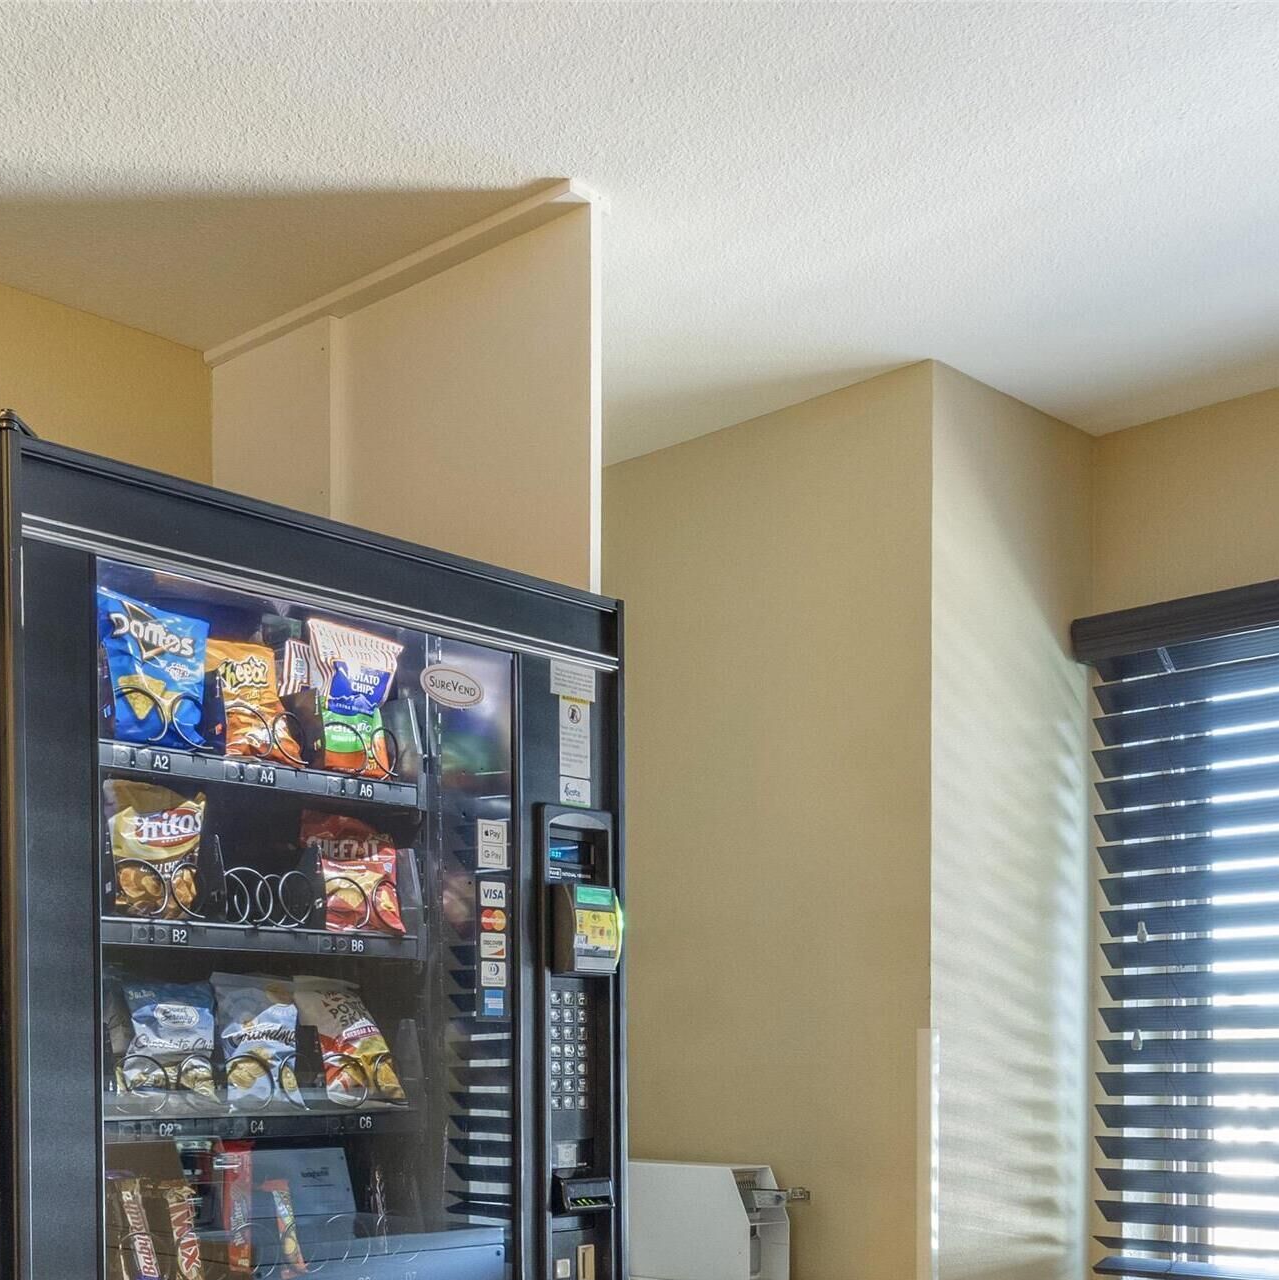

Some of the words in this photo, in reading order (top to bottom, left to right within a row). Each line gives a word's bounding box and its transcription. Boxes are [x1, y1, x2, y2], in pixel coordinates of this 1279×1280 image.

[109, 612, 194, 657] Doritos
[351, 681, 375, 696] CHIPS
[153, 756, 169, 769] A2
[260, 770, 274, 784] A4
[360, 784, 373, 798] A6
[489, 829, 501, 839] Pay
[491, 850, 501, 860] Pay
[483, 889, 504, 900] VISA
[172, 930, 187, 943] B2
[351, 939, 364, 952] B6
[250, 1121, 264, 1134] C4
[359, 1116, 372, 1129] C6
[159, 1123, 174, 1137] C2
[135, 1234, 158, 1277] Baby
